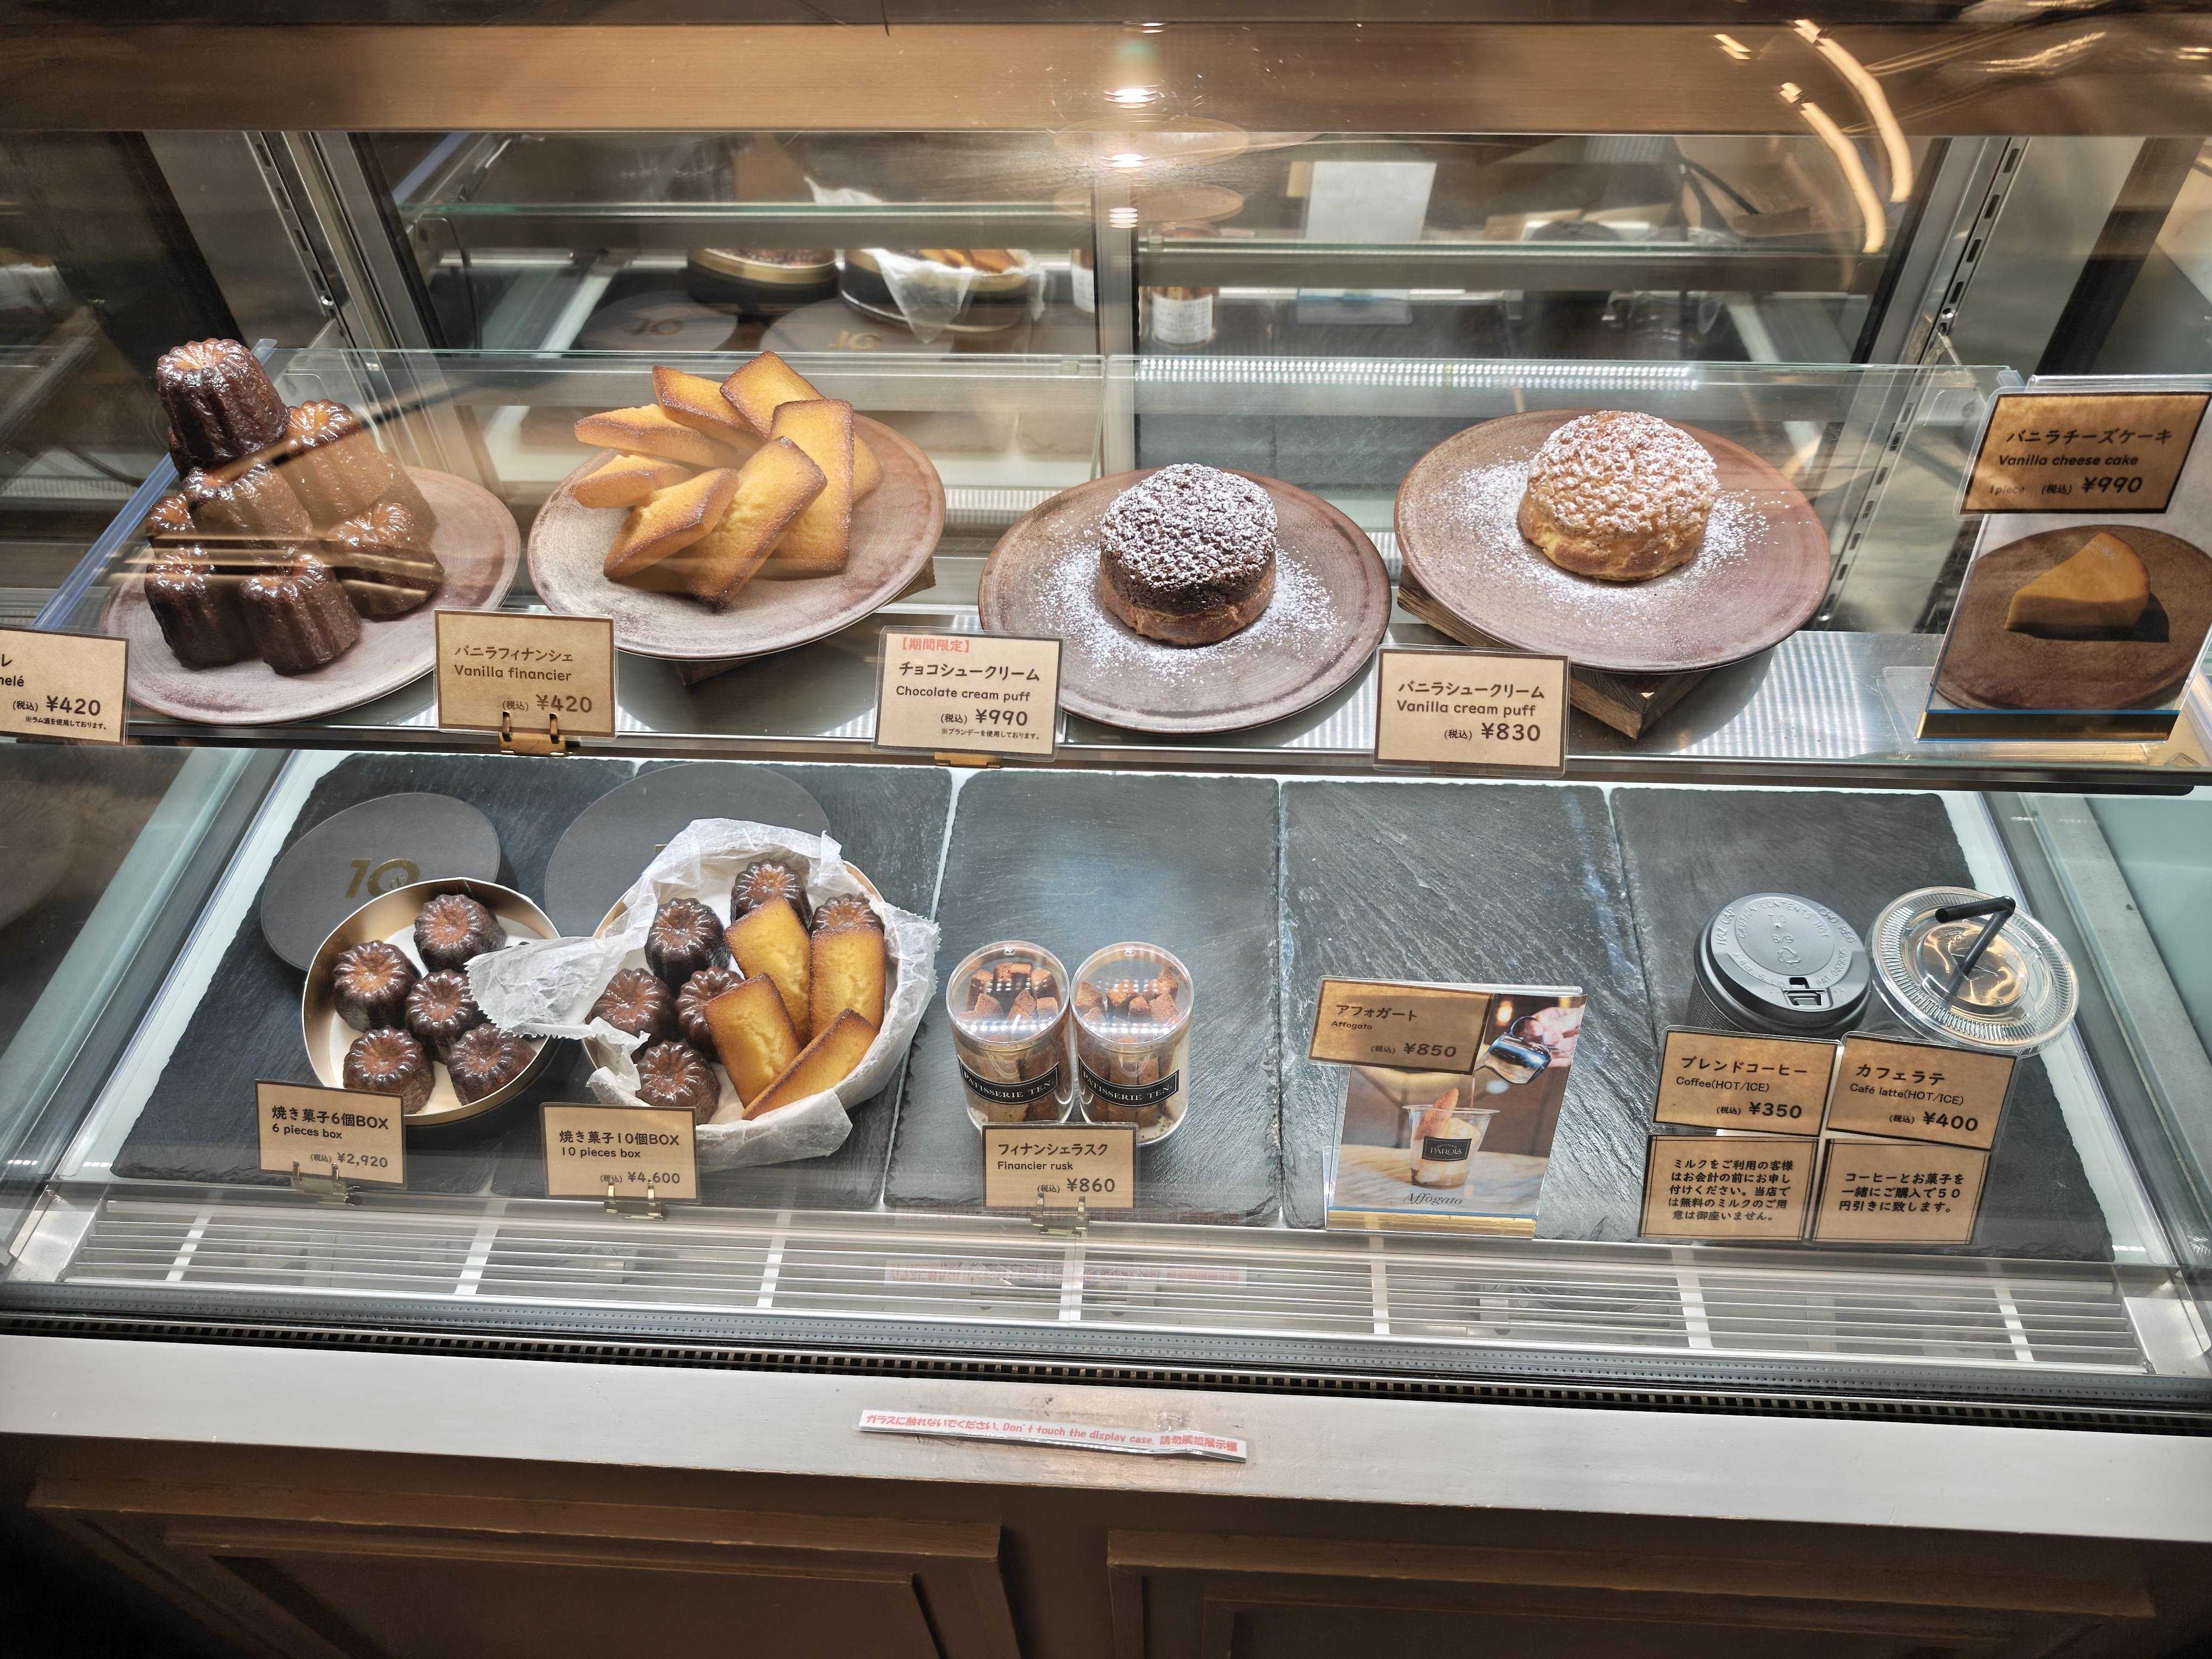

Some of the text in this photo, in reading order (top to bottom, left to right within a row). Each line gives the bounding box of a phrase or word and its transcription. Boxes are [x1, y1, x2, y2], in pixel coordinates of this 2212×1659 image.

[2006, 427, 2173, 445] バニラチーズケーキ
[1999, 454, 2139, 466] Vanilla cheese cake
[2081, 476, 2143, 494] ¥990
[455, 644, 574, 662] バニラフィナンシェ
[901, 637, 970, 653] 【期間限定】
[454, 664, 572, 682] Vanilla financier
[899, 661, 1040, 681] チョコシュークリーム
[896, 686, 1031, 703] Chocolate cream puff
[1398, 680, 1545, 699] バニラシュークリーム
[12, 695, 102, 716] (税込) ¥420
[502, 694, 592, 713] (税込) ¥420
[1397, 700, 1536, 718] Vanilla cream puff
[940, 708, 1028, 726] (税込) ¥990
[941, 728, 1040, 740] ※ブランデーを使用しております。
[1444, 722, 1541, 741] (税込) ¥830
[1336, 1004, 1418, 1022] アフォガート
[1331, 1020, 1373, 1031] Affogato
[1370, 1042, 1457, 1058] (税込) ¥850
[1681, 1056, 1808, 1076] ブレンドコーヒー
[1856, 1063, 1945, 1085] カフェラテ
[1676, 1076, 1770, 1092] Coffee(HOT/ICE)
[1850, 1083, 1964, 1106] Café latte(HOT/ICE)
[272, 1105, 389, 1130] 焼き菓子6個BOX
[1716, 1101, 1803, 1119] (税込) ¥350
[1889, 1111, 1979, 1132] (税込) ¥400
[272, 1123, 343, 1139] 6 pieces box
[559, 1130, 680, 1146] 焼き菓子10個BOX
[562, 1147, 641, 1158] 10 pieces box
[998, 1143, 1108, 1156] フィナンシェラスク
[310, 1152, 388, 1168] (税込) ¥2,920
[997, 1161, 1074, 1170] Financier rusk
[1674, 1159, 1793, 1171] ミルクをご利用の客様
[1037, 1178, 1116, 1193] (税込) ¥860
[1671, 1172, 1791, 1184] はお会計の前にお申し
[1845, 1172, 1965, 1185] コーヒーとお菓子を
[1402, 1192, 1463, 1205] Affogato
[1669, 1185, 1791, 1197] 付けください。当店で
[1669, 1197, 1788, 1209] は無料のミルクのご用
[1839, 1201, 1951, 1213] 円引きに致します。
[1673, 1210, 1773, 1222] 意は御座いません。
[866, 1414, 1000, 1432] ガラスに触れないでください。
[1037, 1426, 1065, 1436] touch
[1069, 1428, 1086, 1438] the
[1090, 1431, 1125, 1442] display
